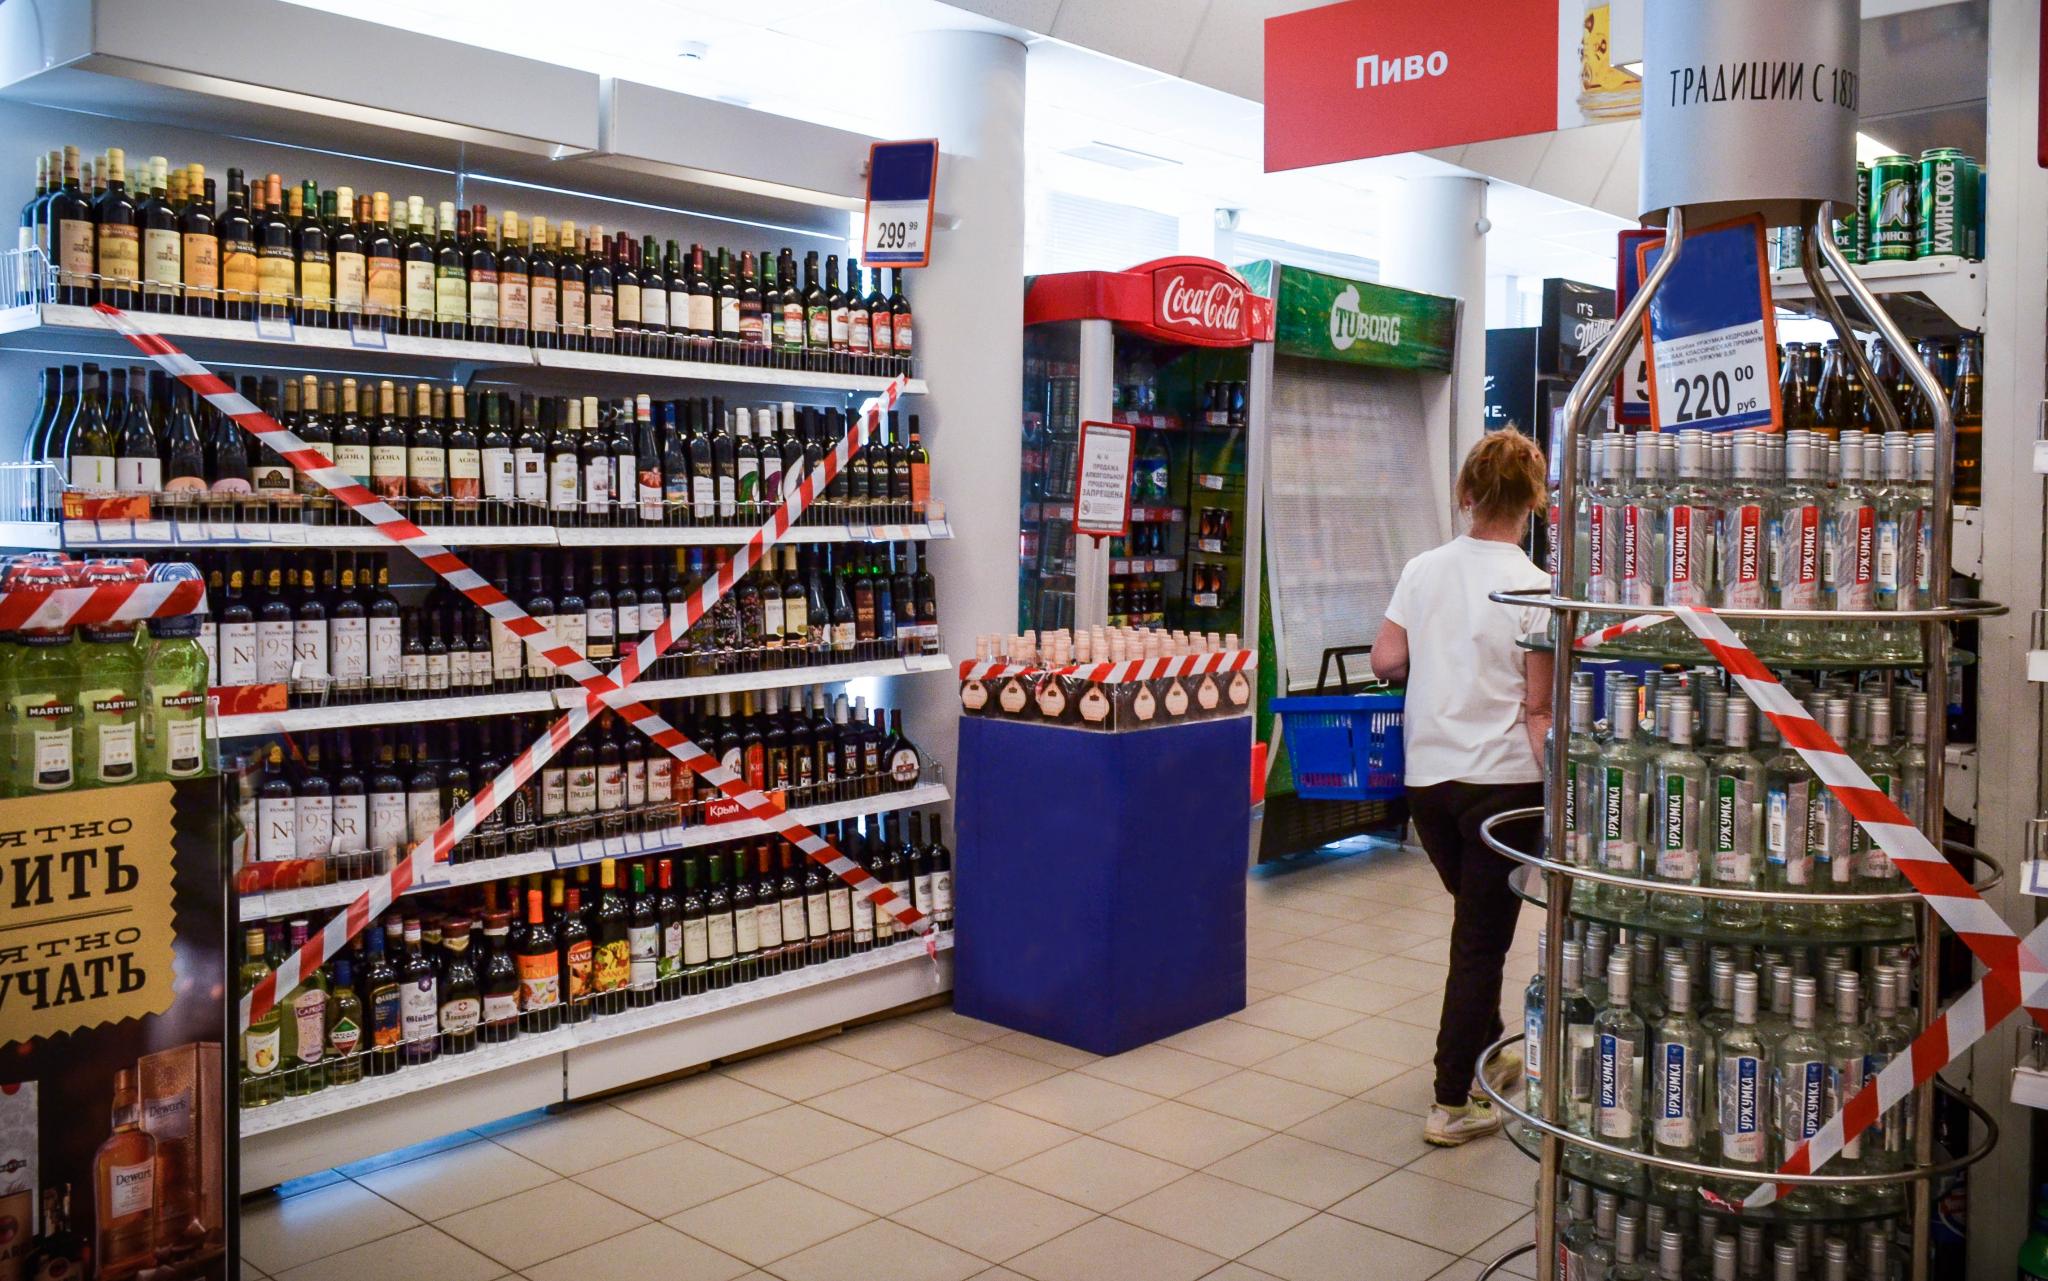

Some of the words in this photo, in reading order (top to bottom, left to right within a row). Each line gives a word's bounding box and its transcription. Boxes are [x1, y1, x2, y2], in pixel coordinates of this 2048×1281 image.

[1356, 51, 1449, 89] Пиво
[1671, 62, 1804, 107] ТРАДИЦИИ
[1934, 162, 1955, 252] КЛИНСКОЕ
[877, 222, 906, 248] 299
[909, 222, 918, 230] 99
[1162, 275, 1245, 331] Coca-Cola
[1335, 306, 1400, 347] TUBORG
[1577, 302, 1594, 317] IT'S
[1674, 370, 1730, 423] 220
[1734, 365, 1754, 382] 00
[1736, 397, 1757, 415] руб
[1082, 488, 1124, 499] ЗАПРЕЩЕНА
[1085, 471, 1124, 480] АЛКОГОЛЬНОЙ
[1087, 480, 1120, 489] ПРОДУКЦИИ
[1092, 463, 1119, 472] ПРОДАЖА
[1591, 523, 1601, 573] УРЖУМКА
[1626, 524, 1635, 577] УРЖУМКА
[1675, 525, 1687, 579] УРЖУМКА
[1743, 525, 1756, 579] УРЖУМКА
[1802, 525, 1815, 580] УРЖУМКА
[1859, 526, 1872, 581] УРЖУМКА
[29, 705, 73, 716] MARTINI
[96, 700, 137, 710] MARTINI
[164, 696, 204, 706] MARTINI
[710, 804, 739, 818] Крым
[1607, 786, 1620, 838] УРЖУМКА
[1668, 794, 1681, 848] УРЖУМКА
[1720, 796, 1733, 849] УРЖУМКА
[0, 844, 139, 909] ИТЬ
[1602, 1053, 1614, 1106] УРЖУМКА
[1668, 1063, 1681, 1116] УРЖУМКА
[1741, 1077, 1754, 1131] УРЖУМКА
[1805, 1081, 1820, 1136] УРЖУМКА
